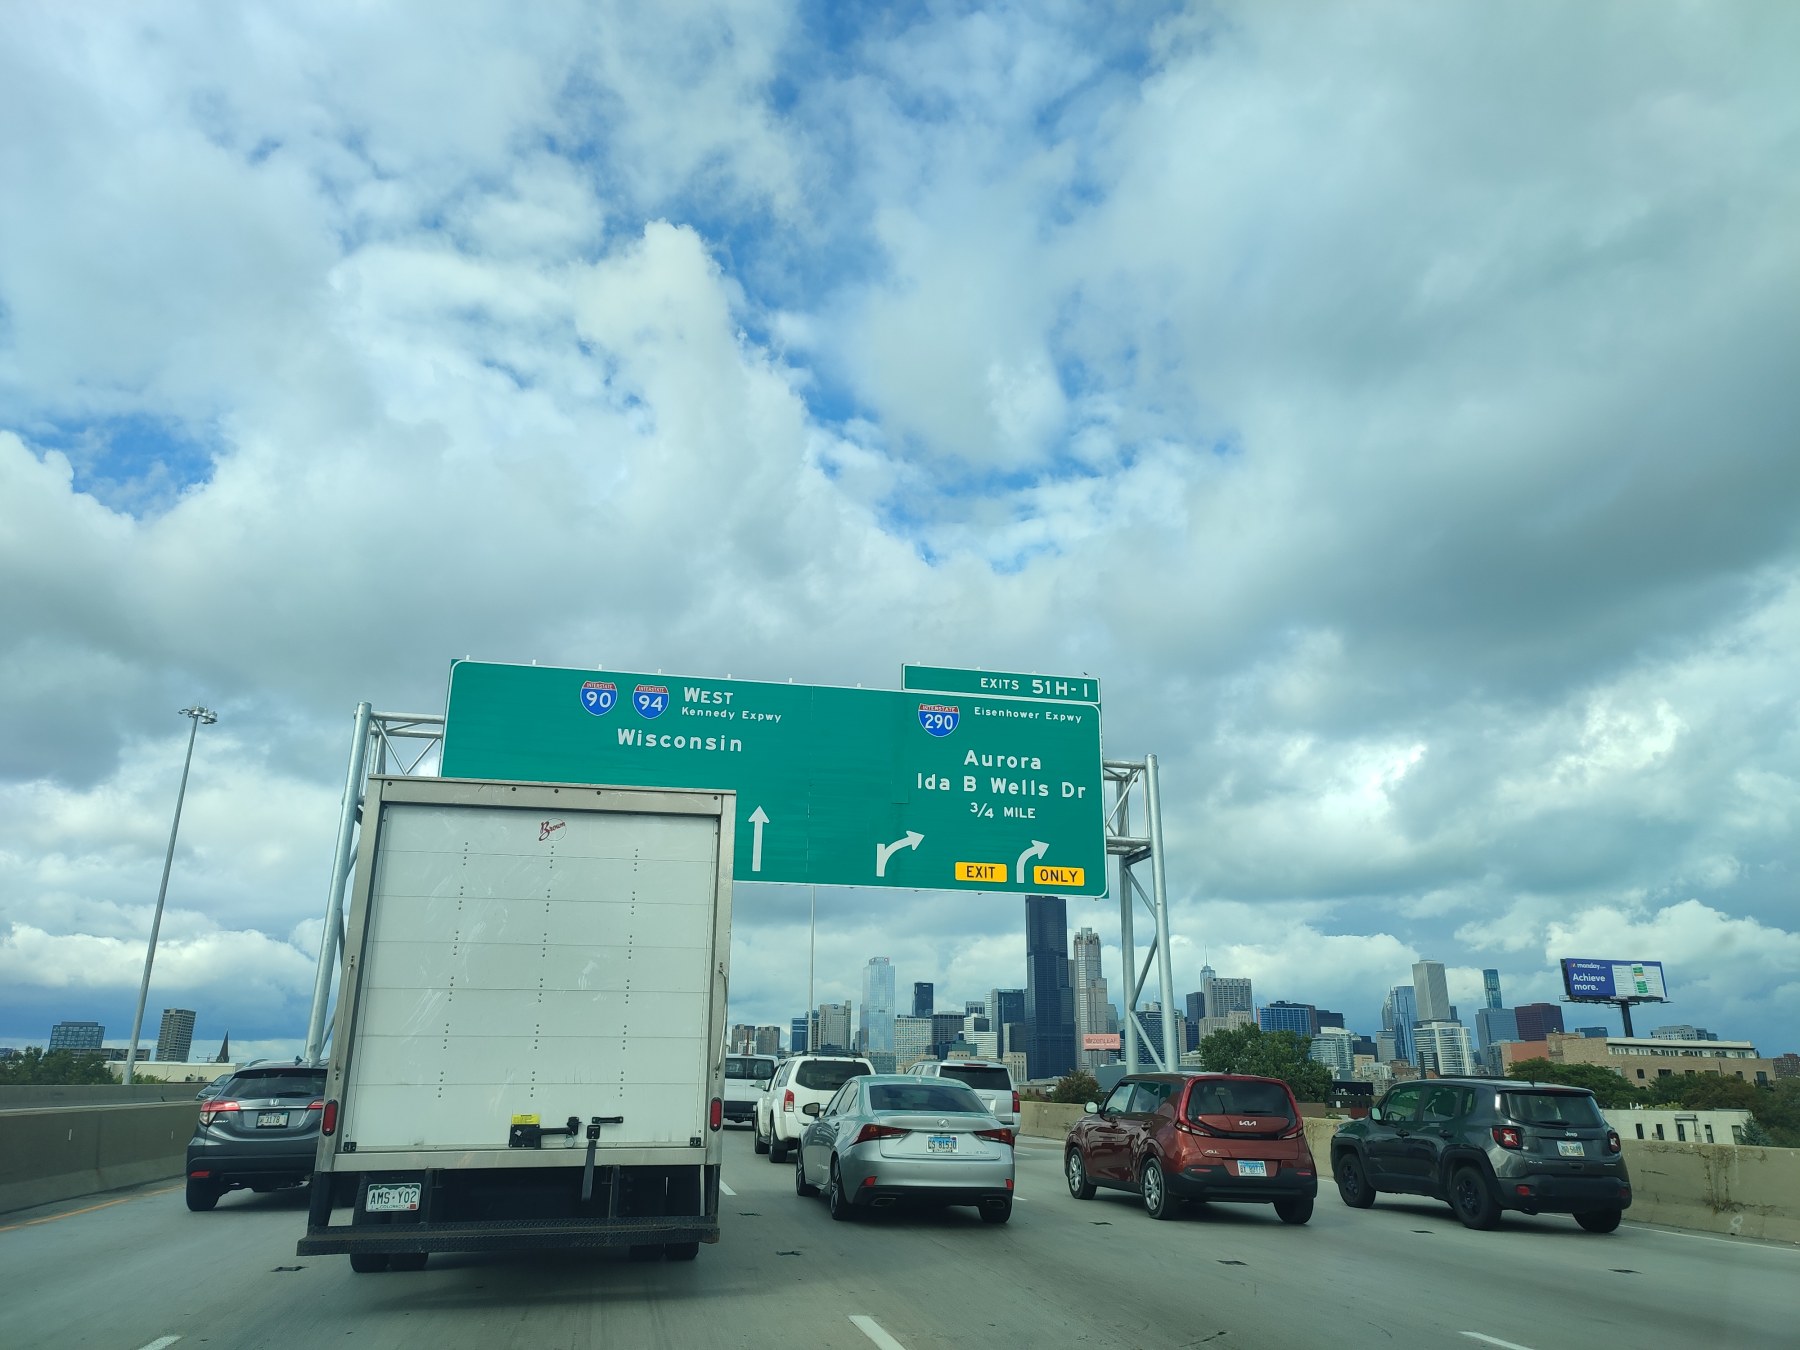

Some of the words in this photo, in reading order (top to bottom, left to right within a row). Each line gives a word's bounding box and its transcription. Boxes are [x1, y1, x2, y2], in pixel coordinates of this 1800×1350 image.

[586, 682, 613, 690] INTERSTATE
[638, 685, 665, 693] INTERSTATE
[981, 678, 1020, 690] EXITS
[586, 691, 612, 708] 90
[638, 695, 663, 712] 94
[684, 687, 733, 705] WEST
[682, 707, 735, 721] Kennedy
[742, 711, 782, 723] Expwy
[925, 714, 954, 730] 290
[974, 707, 1040, 720] Eisenhower
[1046, 712, 1082, 724] Expwy
[617, 728, 742, 752] Wisconsin
[963, 750, 1042, 770] Aurora
[917, 773, 950, 791] Ida
[963, 776, 977, 792] B
[991, 777, 1049, 797] Wells
[1061, 782, 1086, 799] Dr
[970, 802, 994, 819] 3/4
[1004, 807, 1036, 819] MILE
[966, 865, 996, 879] EXIT
[1040, 869, 1078, 883] ONLY
[1572, 973, 1606, 982] Achieve
[1574, 983, 1599, 991] more.
